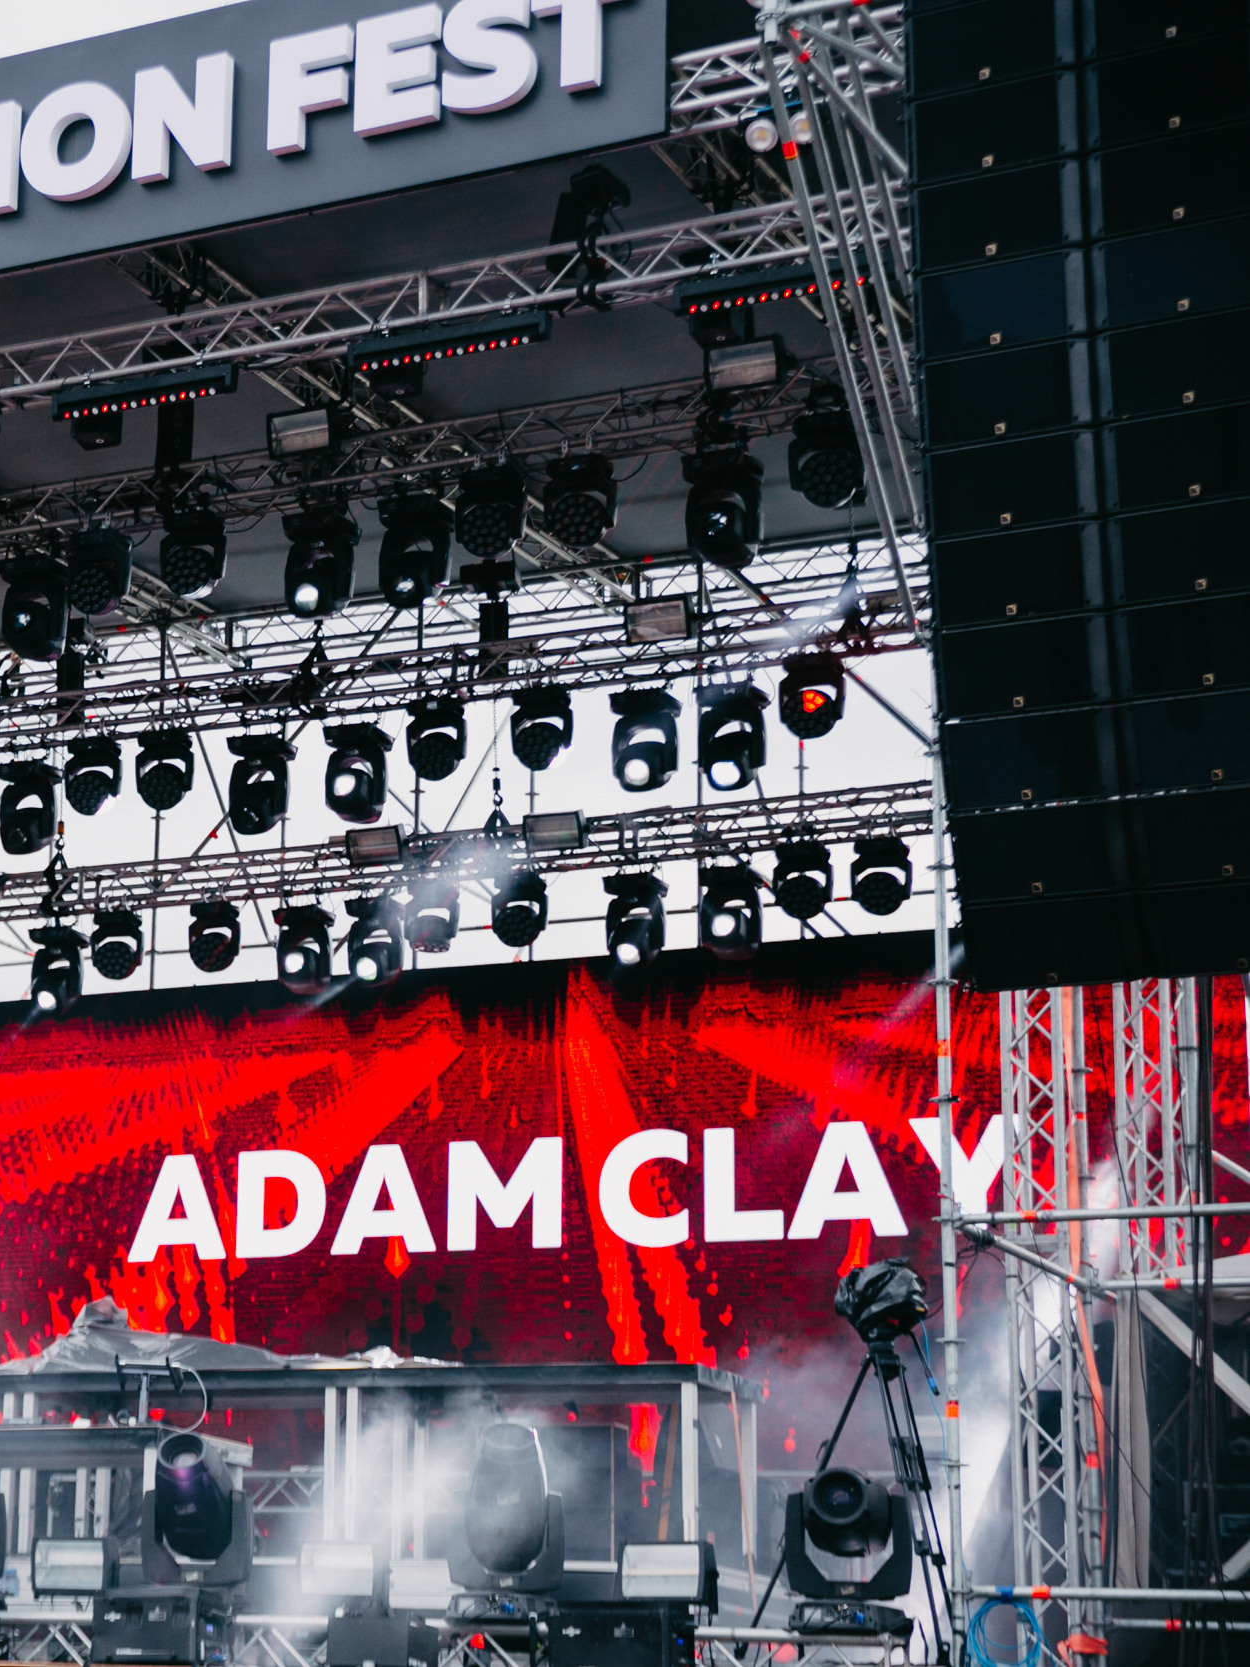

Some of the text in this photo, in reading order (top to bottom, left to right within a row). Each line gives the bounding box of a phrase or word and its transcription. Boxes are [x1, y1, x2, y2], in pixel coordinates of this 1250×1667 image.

[266, 0, 606, 156] FEST
[127, 1114, 1022, 1263] ADAM CLAY
